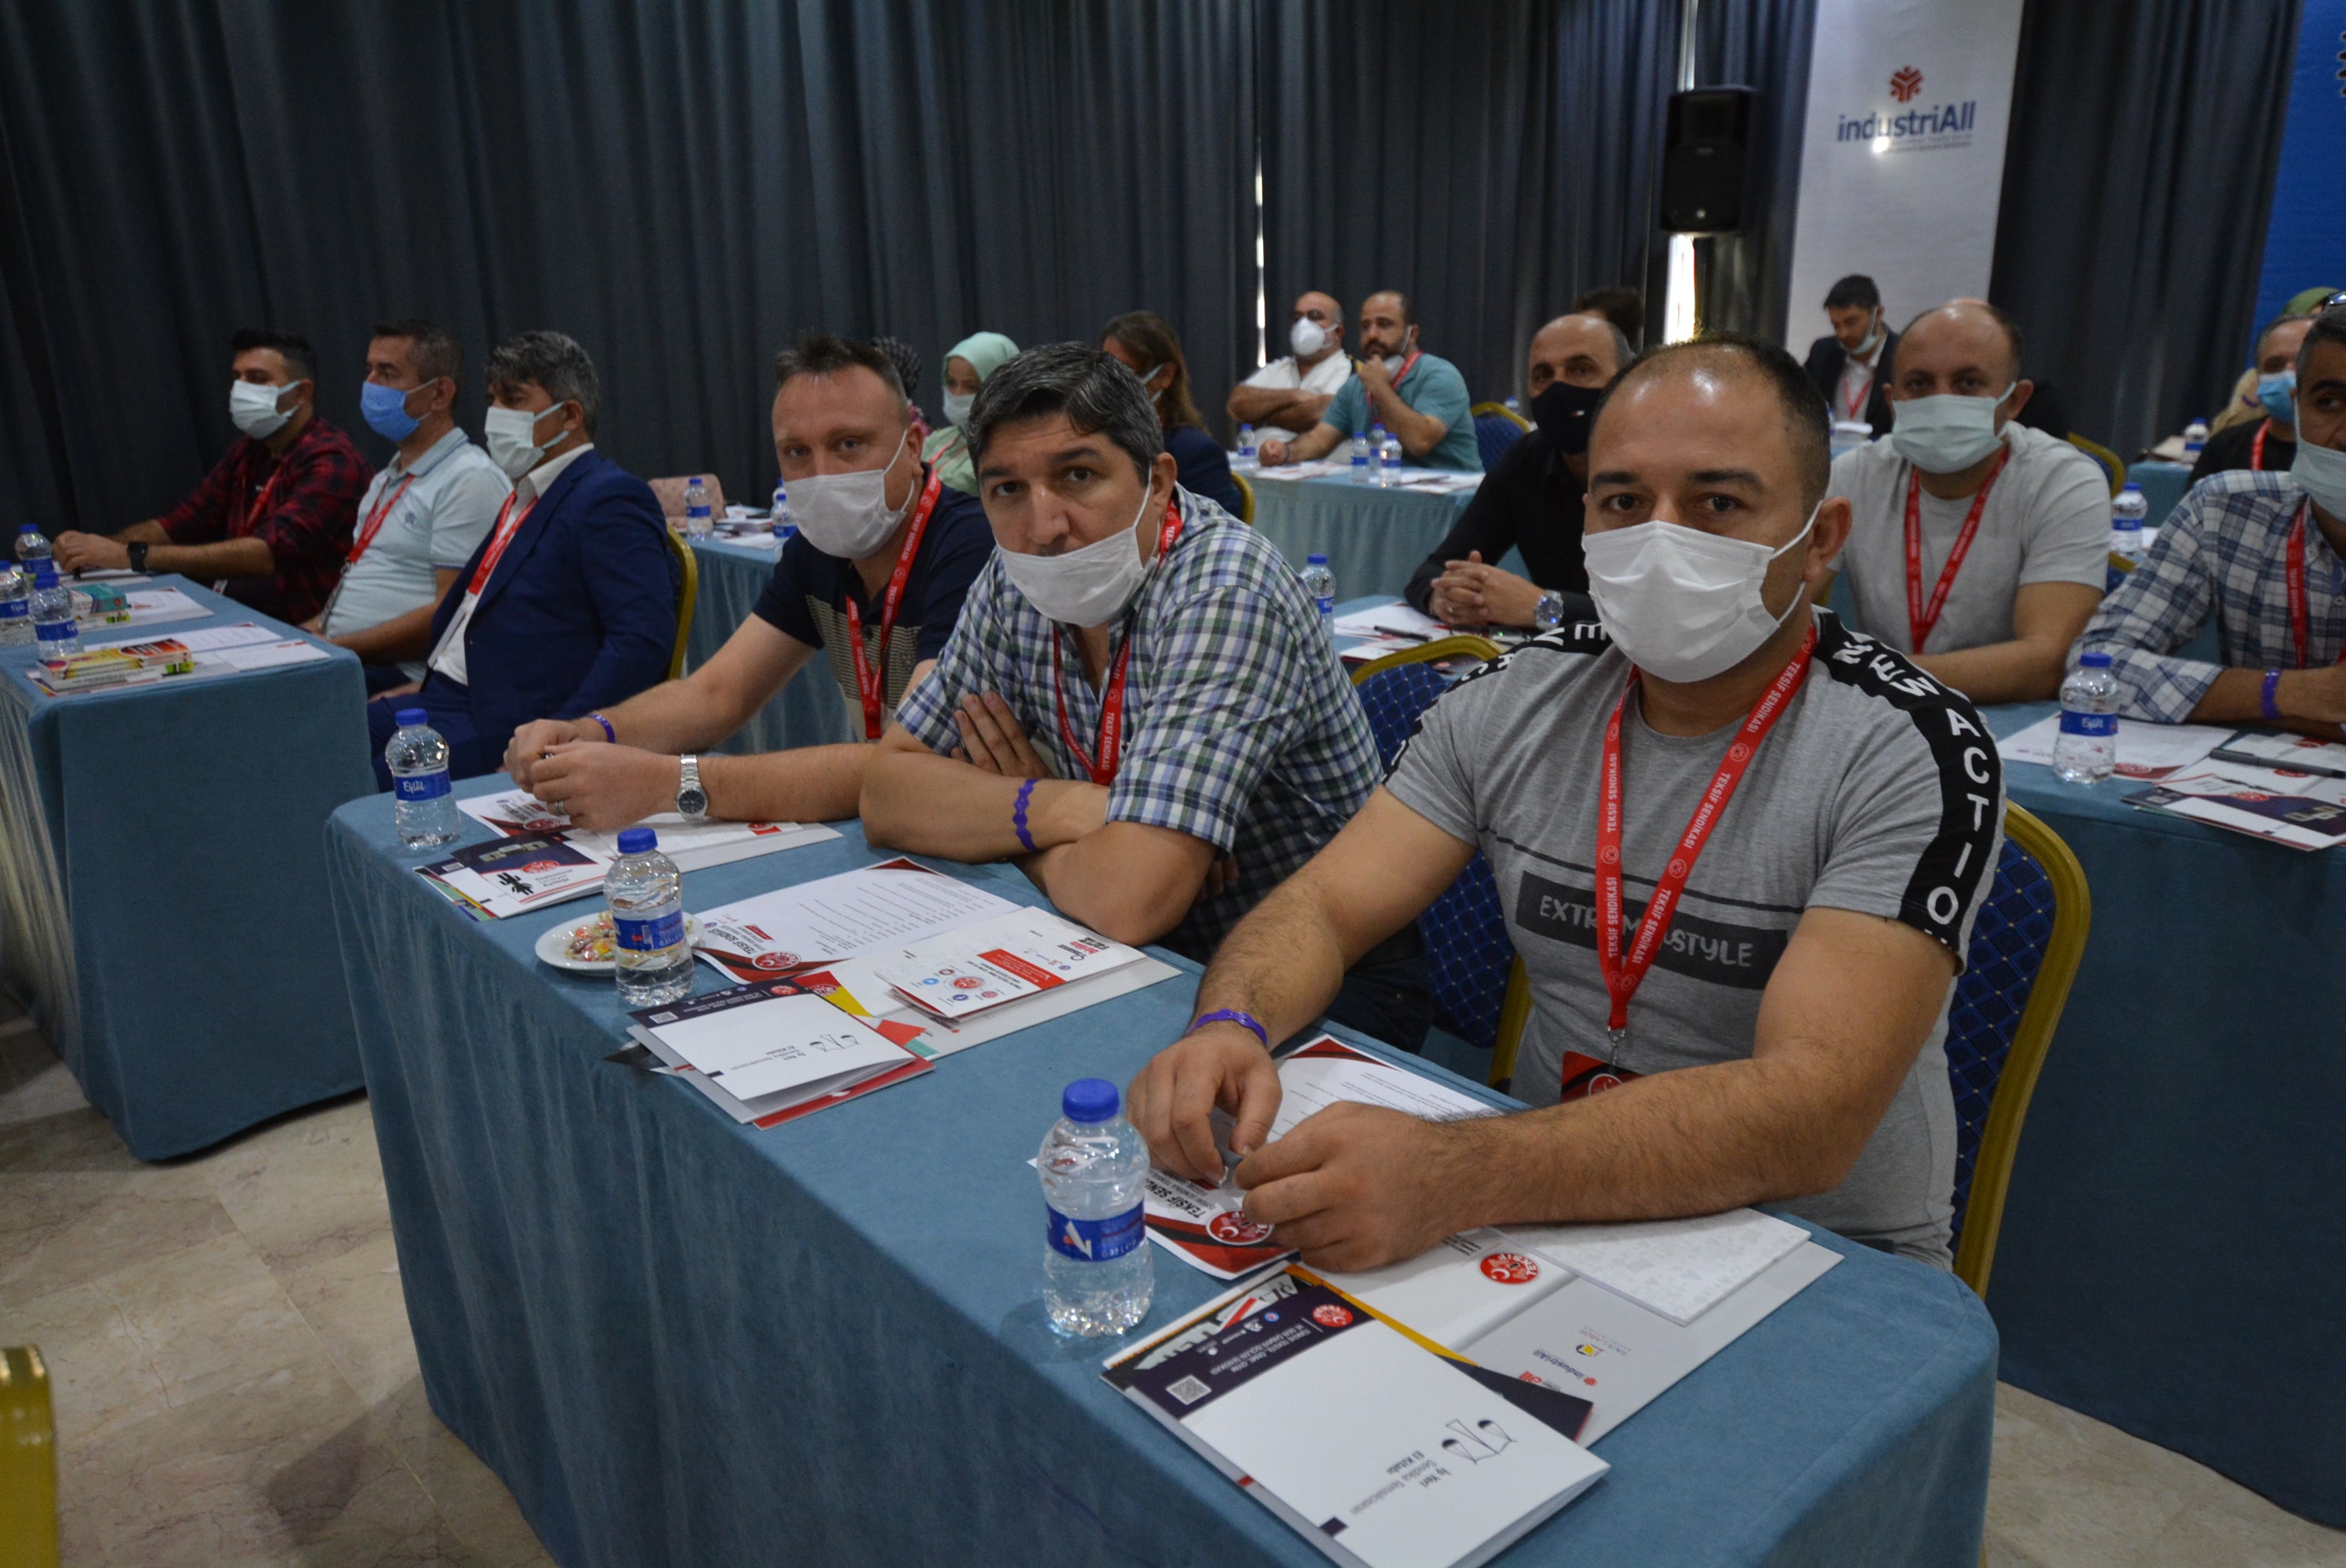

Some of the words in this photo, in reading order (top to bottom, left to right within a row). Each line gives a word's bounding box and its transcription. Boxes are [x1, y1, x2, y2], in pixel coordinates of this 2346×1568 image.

[1838, 100, 1976, 141] industriAll
[1779, 661, 1801, 691] TEKSİF
[1746, 689, 1782, 734] SENDİKASI
[1608, 753, 1618, 800] SENDİKASI
[1708, 771, 1732, 804] TEKSİF
[1607, 802, 1618, 833] TEKSİF
[1683, 801, 1715, 849] SENDİKASI
[1923, 707, 1991, 945] ACTIO
[1607, 877, 1618, 926] SENDİKASI
[1652, 888, 1672, 921] TEKSİF
[1608, 927, 1619, 959] TEKSİF
[1631, 918, 1660, 964] SENDİKASI
[1166, 1196, 1207, 1218] TEKSİF
